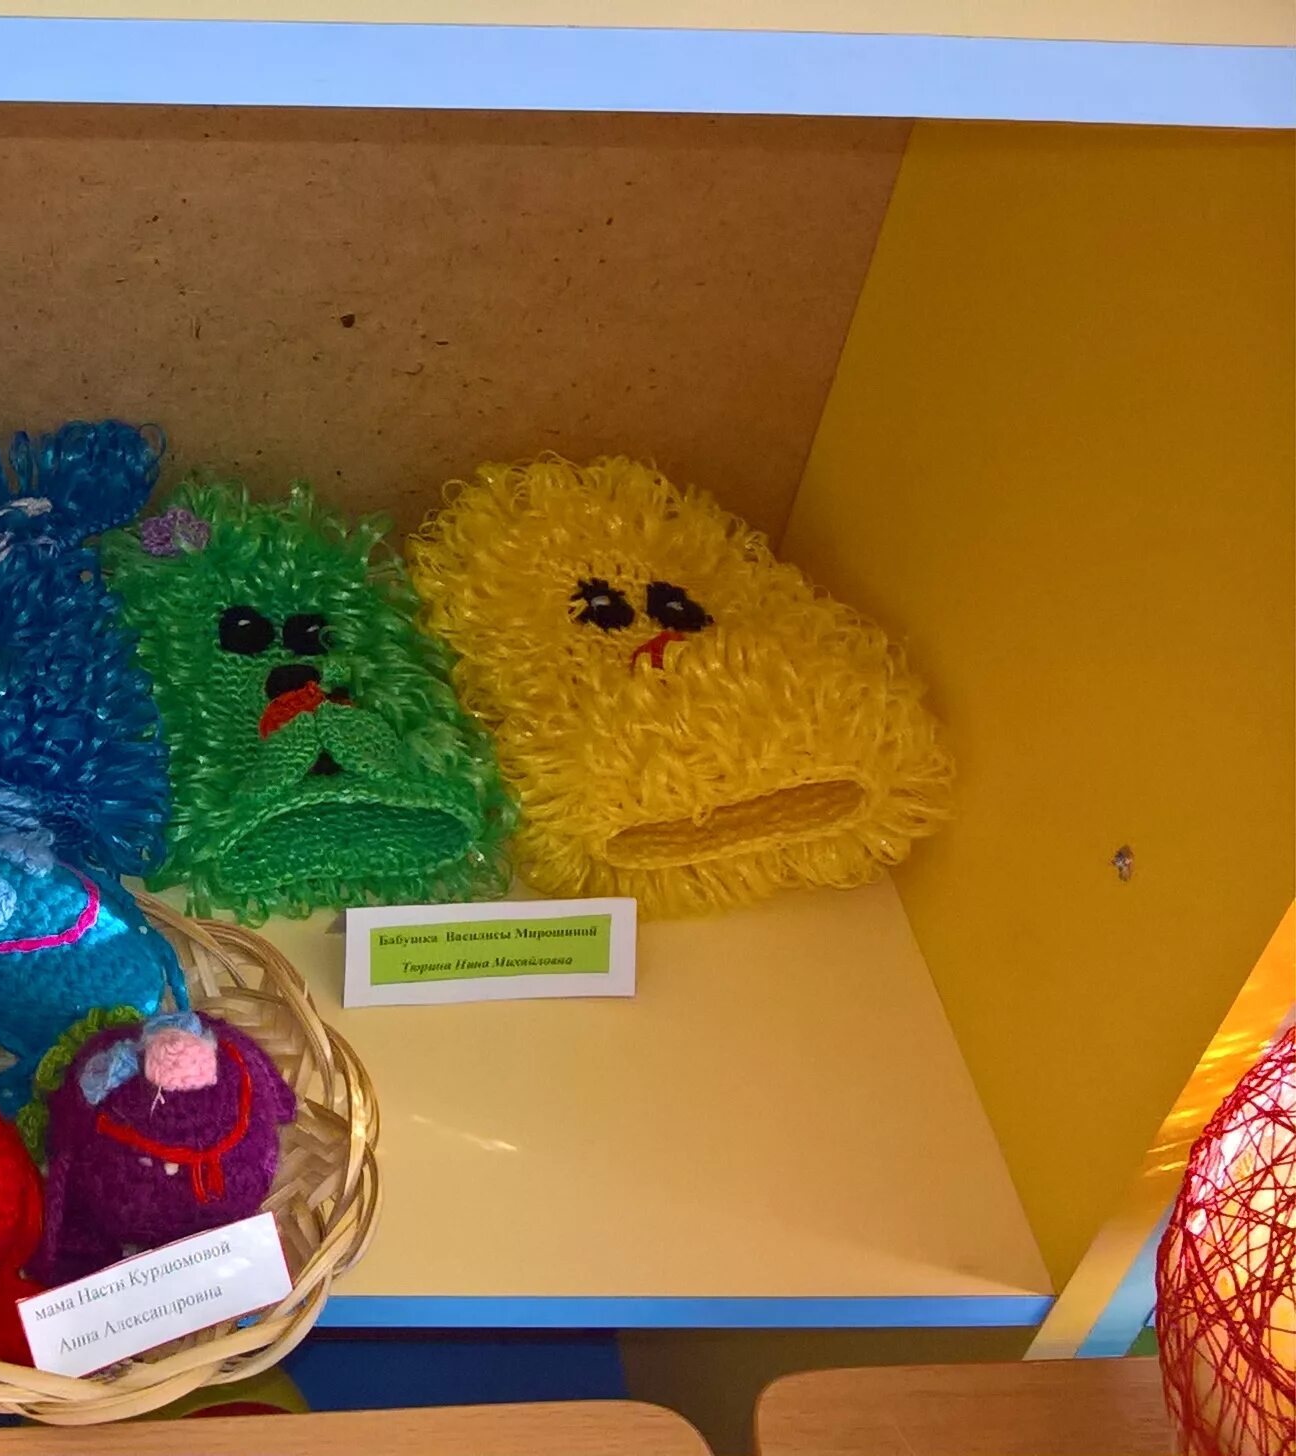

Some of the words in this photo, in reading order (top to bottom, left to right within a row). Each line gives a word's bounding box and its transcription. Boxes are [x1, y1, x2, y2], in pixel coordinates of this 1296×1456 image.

[378, 933, 438, 948] Бабушка
[446, 930, 511, 943] Василисы
[455, 957, 489, 970] Нина
[492, 954, 573, 969] Михайловна
[35, 1297, 75, 1321] мама
[77, 1277, 127, 1304] Насти
[128, 1239, 232, 1286] Курдюмовой
[58, 1331, 100, 1355] Анна
[103, 1283, 223, 1339] Александровна
